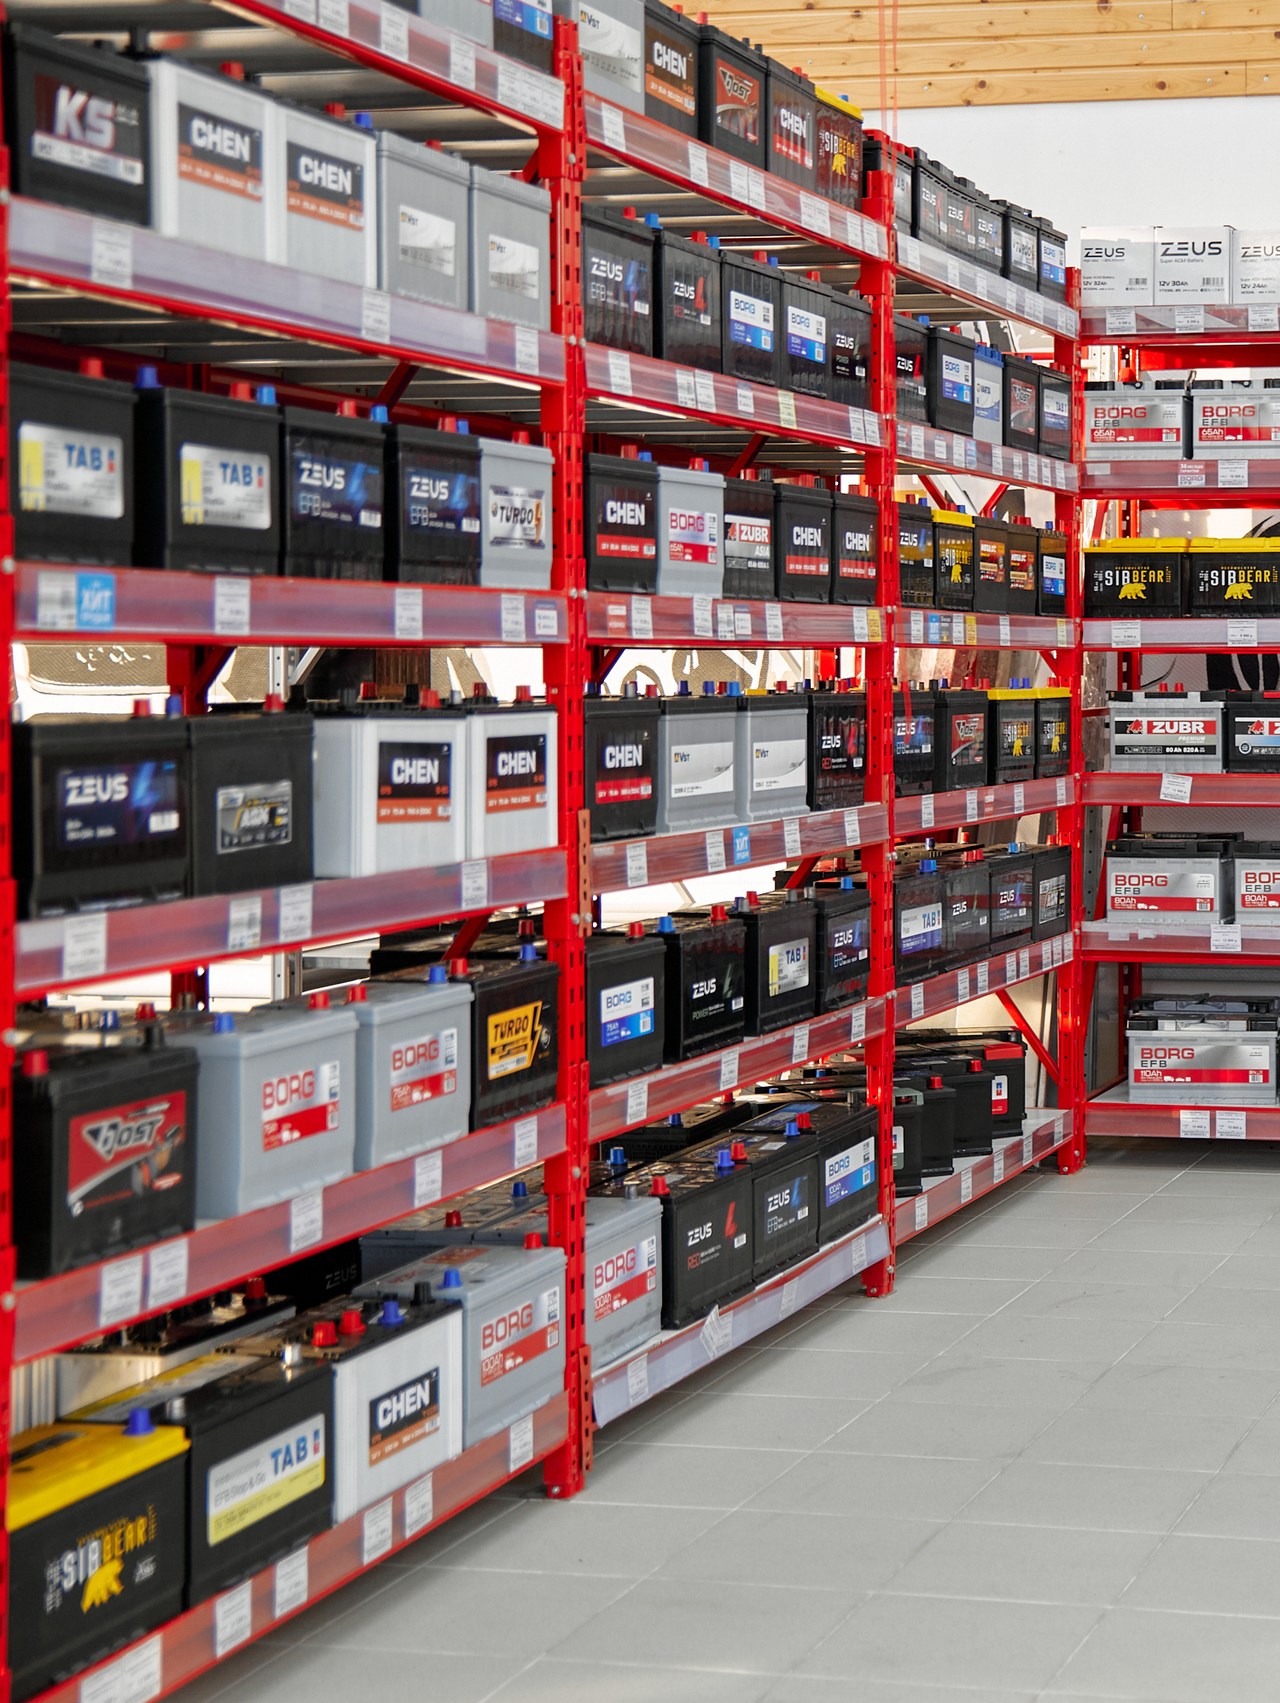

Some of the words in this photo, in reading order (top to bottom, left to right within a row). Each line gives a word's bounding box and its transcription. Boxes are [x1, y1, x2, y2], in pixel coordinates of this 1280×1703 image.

[653, 41, 687, 80] CHEN
[55, 88, 115, 150] KS
[780, 108, 807, 138] CHEN
[190, 117, 251, 164] CHEN
[298, 154, 352, 195] CHEN
[922, 187, 937, 206] ZEUS
[948, 205, 963, 222] ZEUS
[1084, 247, 1125, 258] ZEUS
[1160, 241, 1222, 257] ZEUS
[591, 257, 623, 282] ZEUS
[674, 281, 695, 300] ZEUS
[734, 298, 755, 315] BORG
[791, 312, 810, 329] BORG
[836, 334, 854, 350] ZEUS
[897, 356, 913, 373] ZEUS
[945, 360, 960, 374] BORG
[1094, 406, 1147, 419] BORG
[1202, 405, 1256, 418] BORG
[1094, 419, 1120, 428] EFB
[1201, 428, 1224, 436] 65Ah
[1202, 418, 1228, 428] EFB
[1093, 429, 1116, 437] 65Ah
[64, 444, 104, 471] TAB
[220, 462, 253, 486] TAB
[300, 461, 345, 490] ZEUS
[410, 476, 449, 500] ZEUS
[499, 505, 534, 525] TURBO
[605, 500, 645, 526] CHEN
[670, 512, 705, 533] BORG
[740, 526, 769, 543] ZUBR
[792, 526, 821, 548] CHEN
[845, 531, 870, 552] CHEN
[900, 532, 918, 547] ZEUS
[754, 545, 770, 557] ASIA
[1105, 570, 1164, 586] SIBBEAR
[1210, 570, 1271, 586] SIBBEAR
[1153, 721, 1204, 734] ZUBR
[822, 735, 841, 749] ZEUS
[498, 750, 536, 776] CHEN
[605, 744, 643, 768] CHEN
[392, 757, 439, 784] CHEN
[65, 774, 129, 806] ZEUS
[1115, 875, 1168, 886] BORG
[1000, 890, 1014, 904] ZEUS
[1115, 887, 1141, 895] EFB
[952, 901, 967, 916] ZEUS
[922, 911, 936, 930] TAB
[834, 929, 853, 948] ZEUS
[785, 949, 801, 965] TAB
[692, 978, 717, 999] ZEUS
[606, 991, 632, 1010] BORG
[494, 1015, 529, 1042] TURBO
[392, 1039, 439, 1071] BORG
[1141, 1048, 1194, 1060] BORG
[1141, 1060, 1167, 1068] EFB
[262, 1070, 315, 1110] BORG
[828, 1155, 850, 1177] BORG
[767, 1189, 790, 1213] ZEUS
[687, 1222, 712, 1247] ZEUS
[325, 1266, 357, 1289] ZEUS
[594, 1248, 637, 1289] BORG
[482, 1302, 533, 1350] BORG
[376, 1381, 430, 1429] CHEN
[271, 1434, 308, 1475] TAB
[60, 1515, 148, 1593] SIBBEAR
